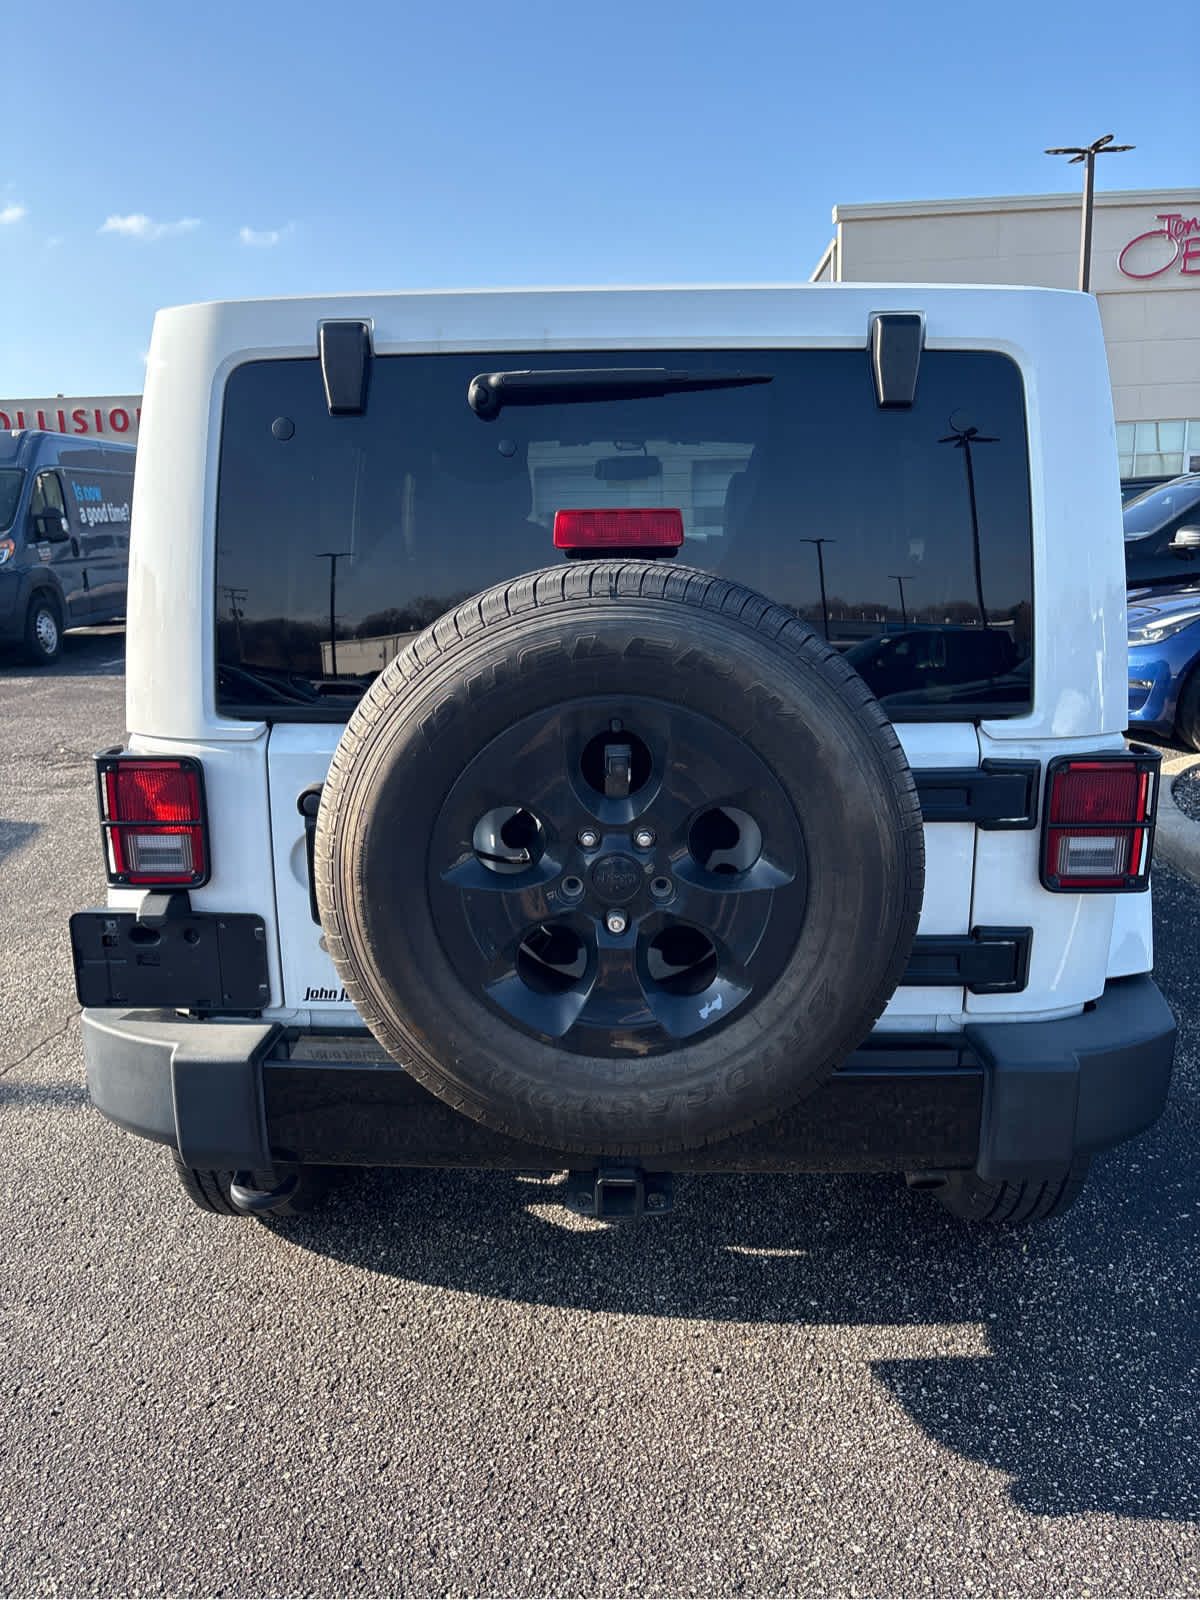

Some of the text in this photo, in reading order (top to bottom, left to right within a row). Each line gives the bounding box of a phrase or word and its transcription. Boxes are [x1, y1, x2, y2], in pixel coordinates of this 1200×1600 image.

[79, 503, 130, 527] a good time?
[303, 987, 338, 1002] John
